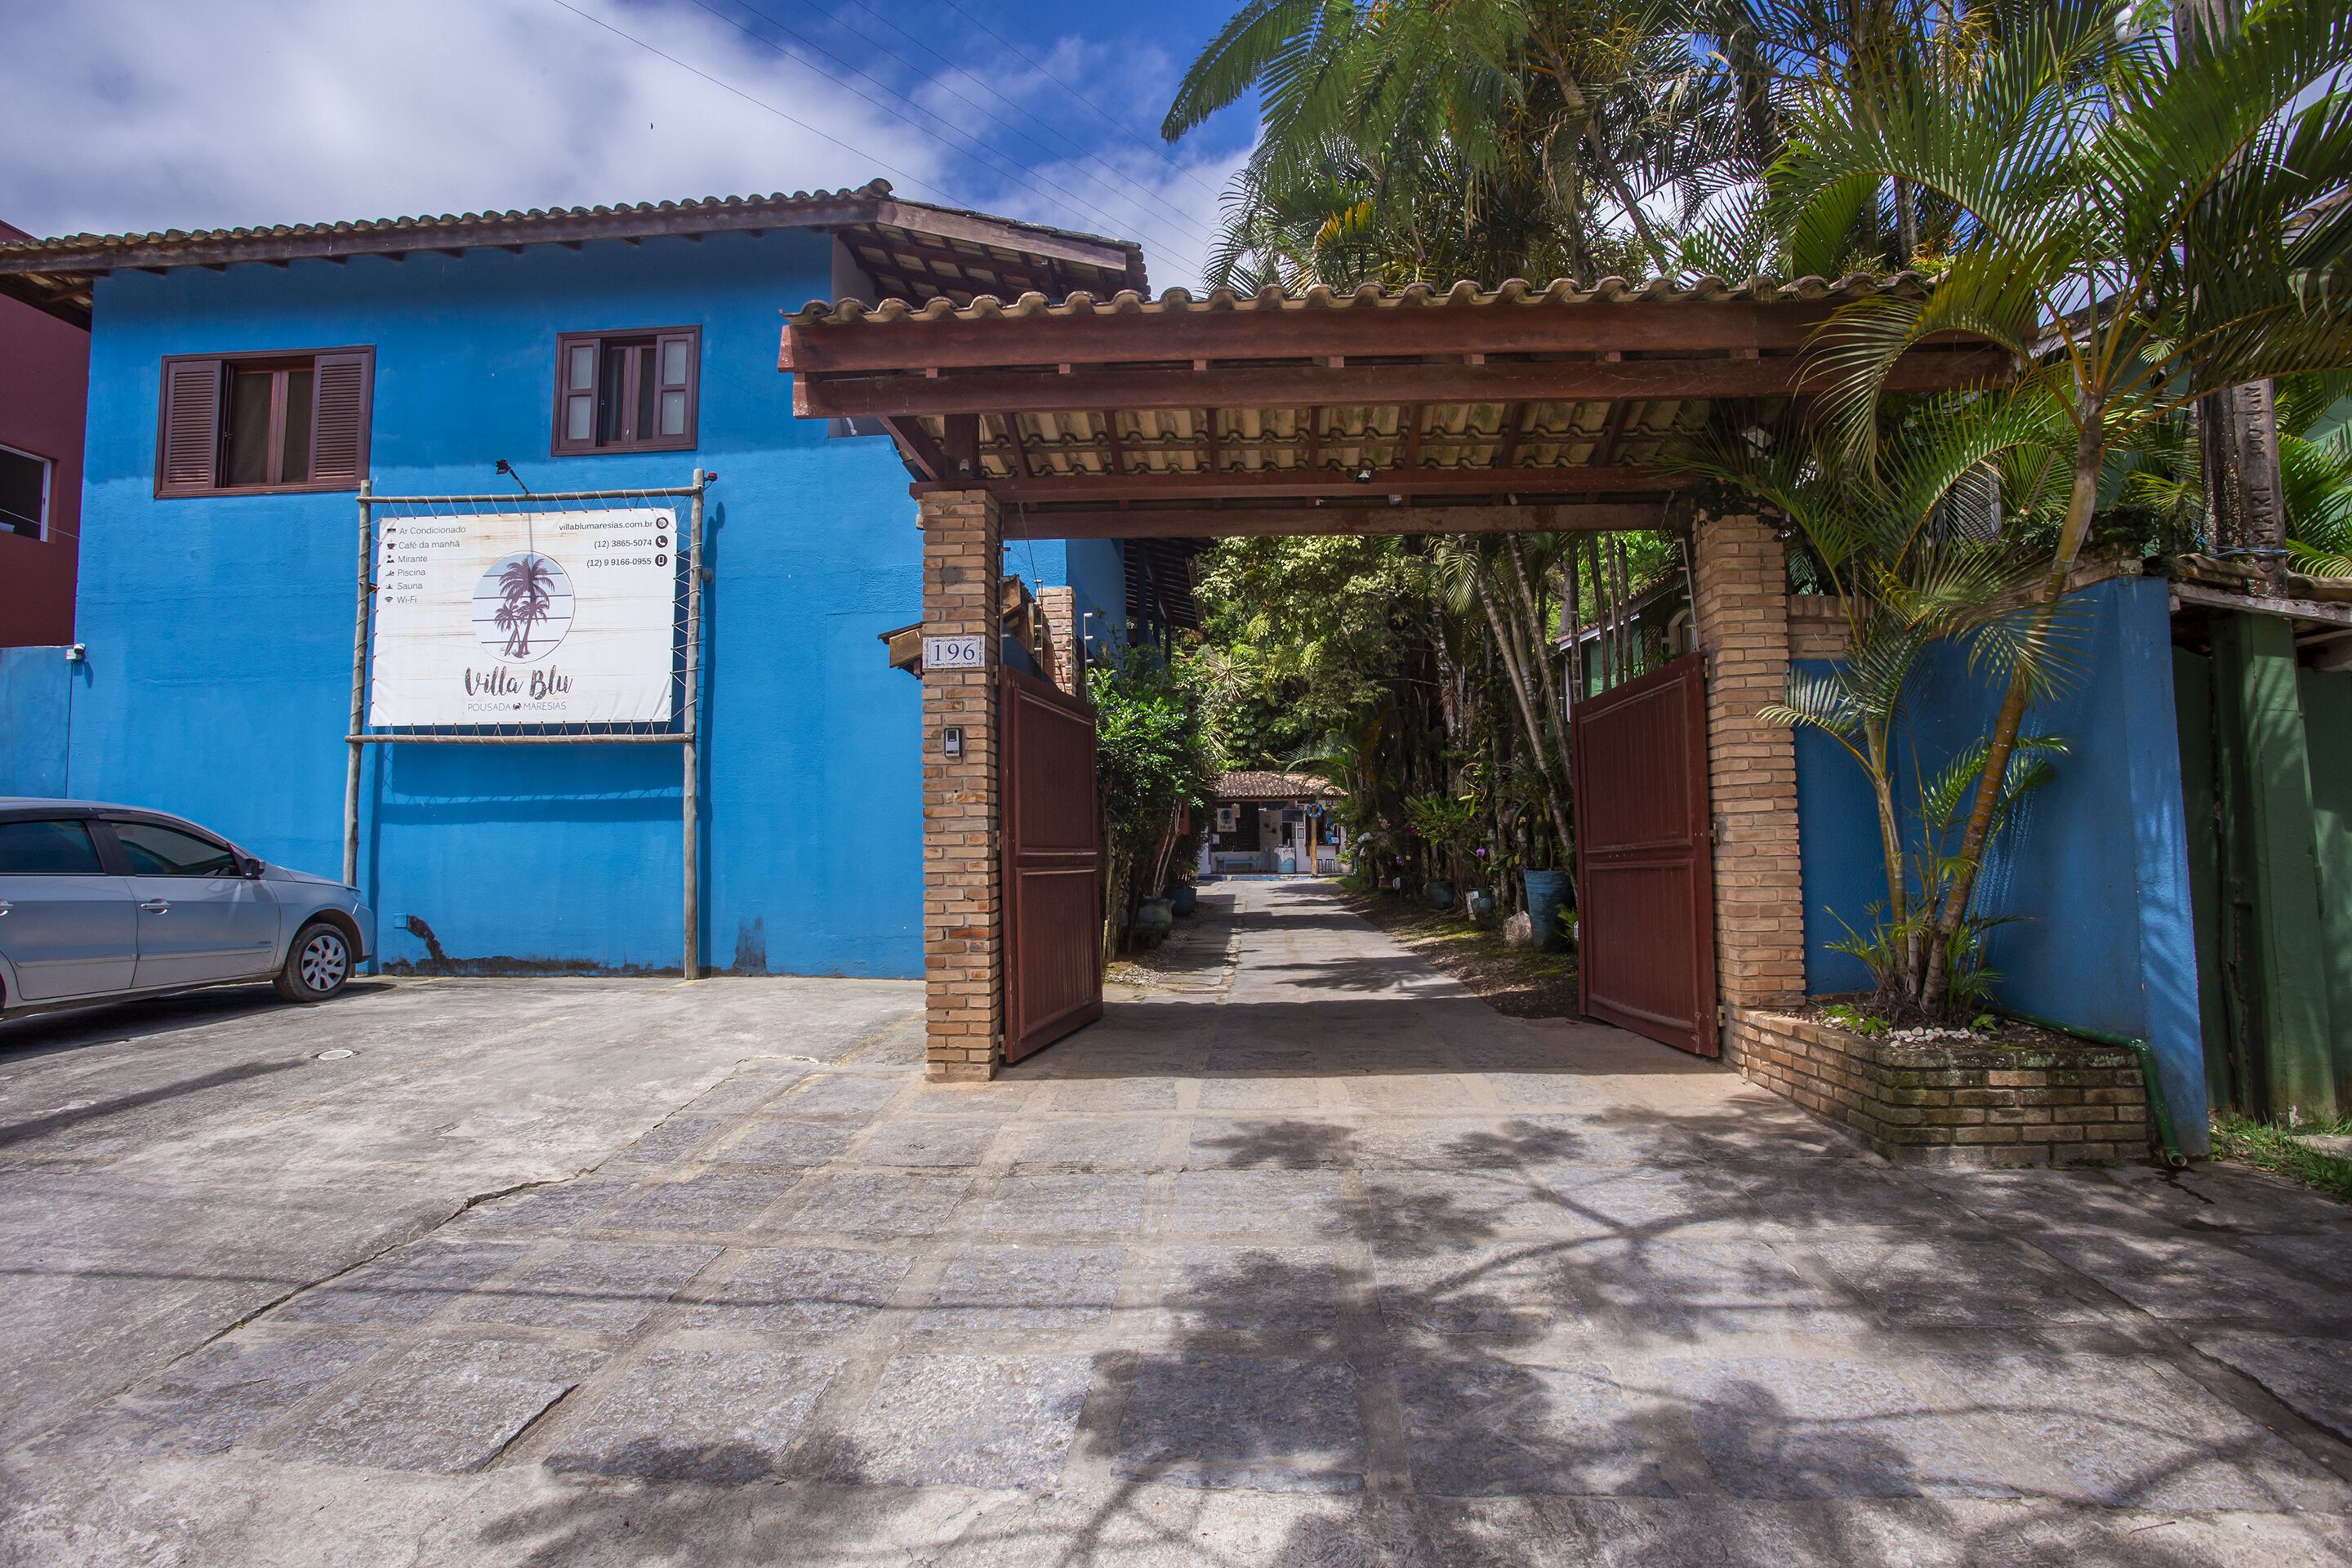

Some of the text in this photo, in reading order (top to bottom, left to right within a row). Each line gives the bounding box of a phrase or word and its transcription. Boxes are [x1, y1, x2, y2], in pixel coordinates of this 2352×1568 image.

[410, 526, 466, 535] Condicionado
[559, 520, 653, 531] villablumaresias.com.br
[399, 540, 461, 550] Café da manhã
[594, 539, 653, 549] (12) 3865-5074
[586, 559, 603, 568] (12)
[611, 558, 652, 566] 9166-0955
[397, 568, 426, 577] Piscina
[396, 595, 417, 604] Wi-Fi
[934, 643, 975, 662] 196
[465, 664, 573, 700] Villa Blu
[467, 702, 567, 712] POUSADA MARESIAS
